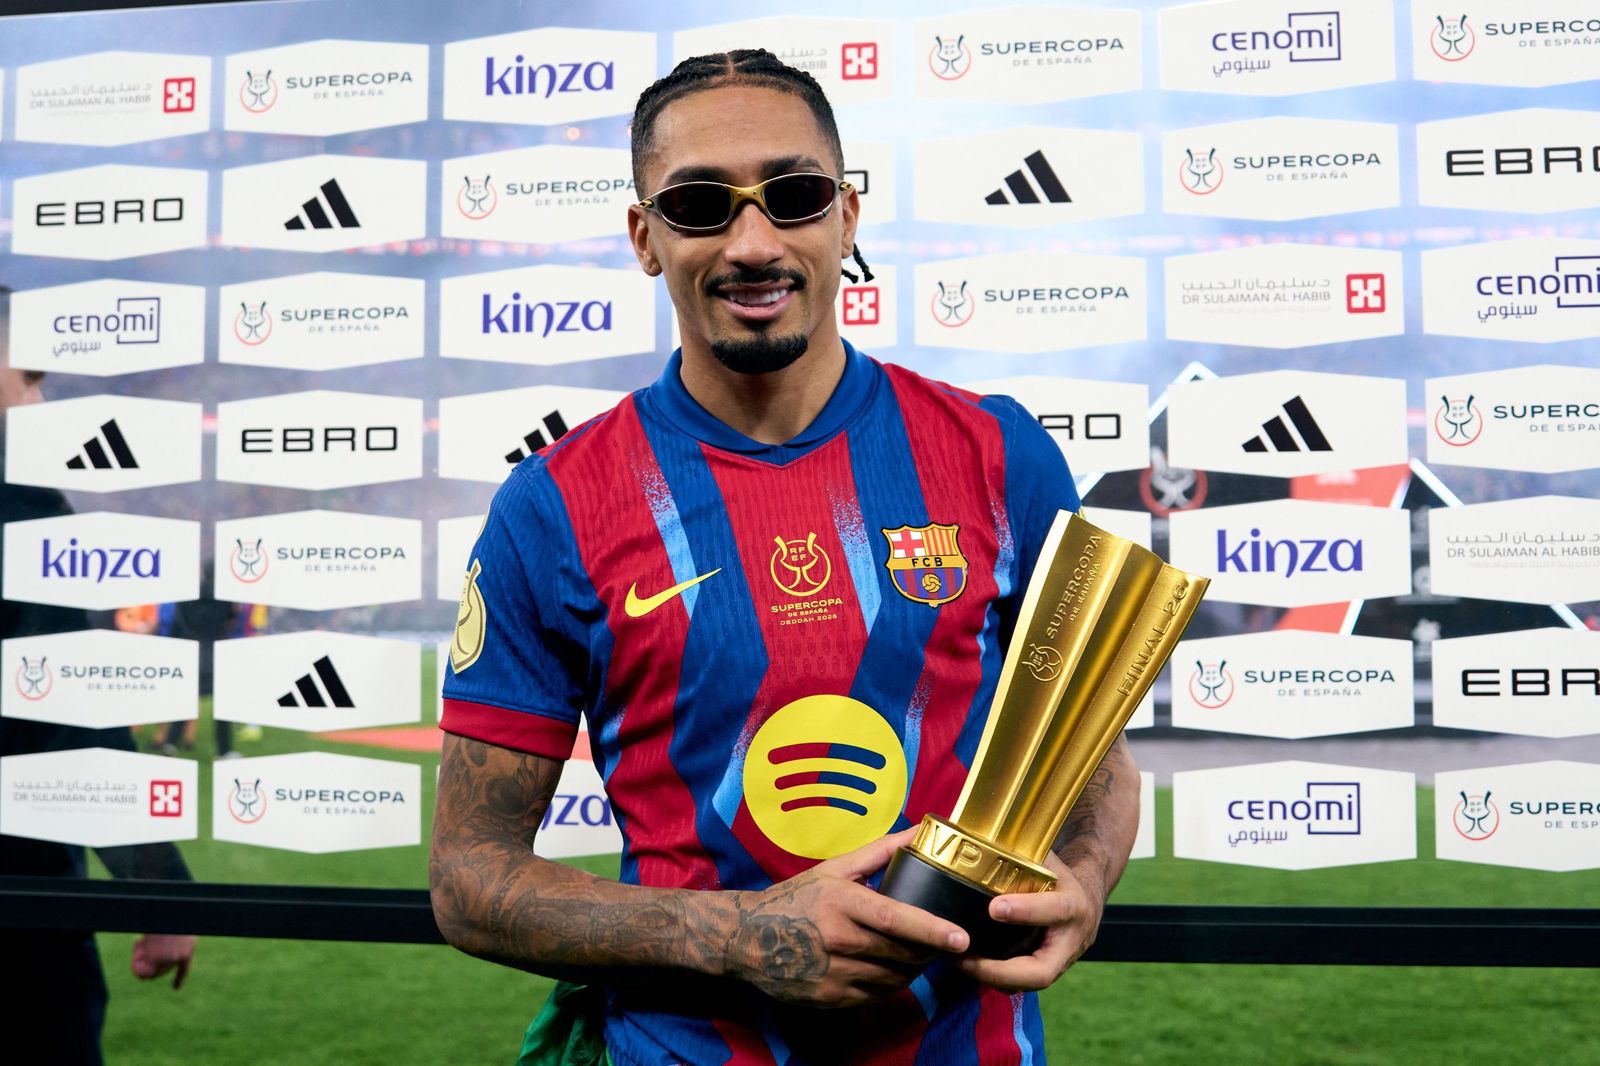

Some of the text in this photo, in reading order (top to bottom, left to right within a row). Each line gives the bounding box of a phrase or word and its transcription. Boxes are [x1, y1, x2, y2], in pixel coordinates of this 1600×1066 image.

[1485, 20, 1600, 36] SUPERCO
[981, 38, 1123, 55] SUPERCOPA
[1518, 40, 1537, 48] DE
[1037, 55, 1092, 66] ESPAÑA
[287, 72, 412, 89] SUPERCOPA
[486, 55, 613, 98] kinza
[335, 88, 384, 98] ESPAÑA
[1234, 153, 1380, 169] SUPERCOPA
[1446, 146, 1600, 176] EBR
[1291, 170, 1348, 180] ESPAÑA
[36, 198, 183, 226] EBRO
[985, 287, 1129, 302] SUPERCOPA
[1182, 291, 1330, 304] DR SULAIMAN AL HABIB
[281, 307, 408, 321] SUPERCOPA
[483, 292, 611, 338] kinza
[1041, 304, 1096, 313] ESPAÑA
[330, 323, 380, 332] ESPAÑA
[1494, 404, 1600, 418] SUPERC
[1038, 413, 1121, 440] RO
[1558, 424, 1600, 432] ESPA
[242, 427, 397, 453] EBRO
[277, 547, 405, 560] SUPERCOPA
[1217, 528, 1363, 578] kinza
[1448, 546, 1600, 558] DR SULAIMAN AL HABIB
[42, 538, 160, 583] kinza
[912, 557, 943, 567] FCB
[327, 564, 376, 572] ESPAÑA
[1046, 535, 1102, 640] SUPERCOPA
[771, 598, 842, 612] SUPERCOPA
[61, 666, 183, 679] SUPERCOPA
[1245, 670, 1395, 683] SUPERCOPA
[1462, 669, 1600, 696] EBR
[1304, 687, 1361, 696] ESPAÑA
[276, 789, 405, 803] SUPERCOPA
[304, 806, 376, 815] DE ESPAÑA
[1510, 802, 1600, 814] SUPER
